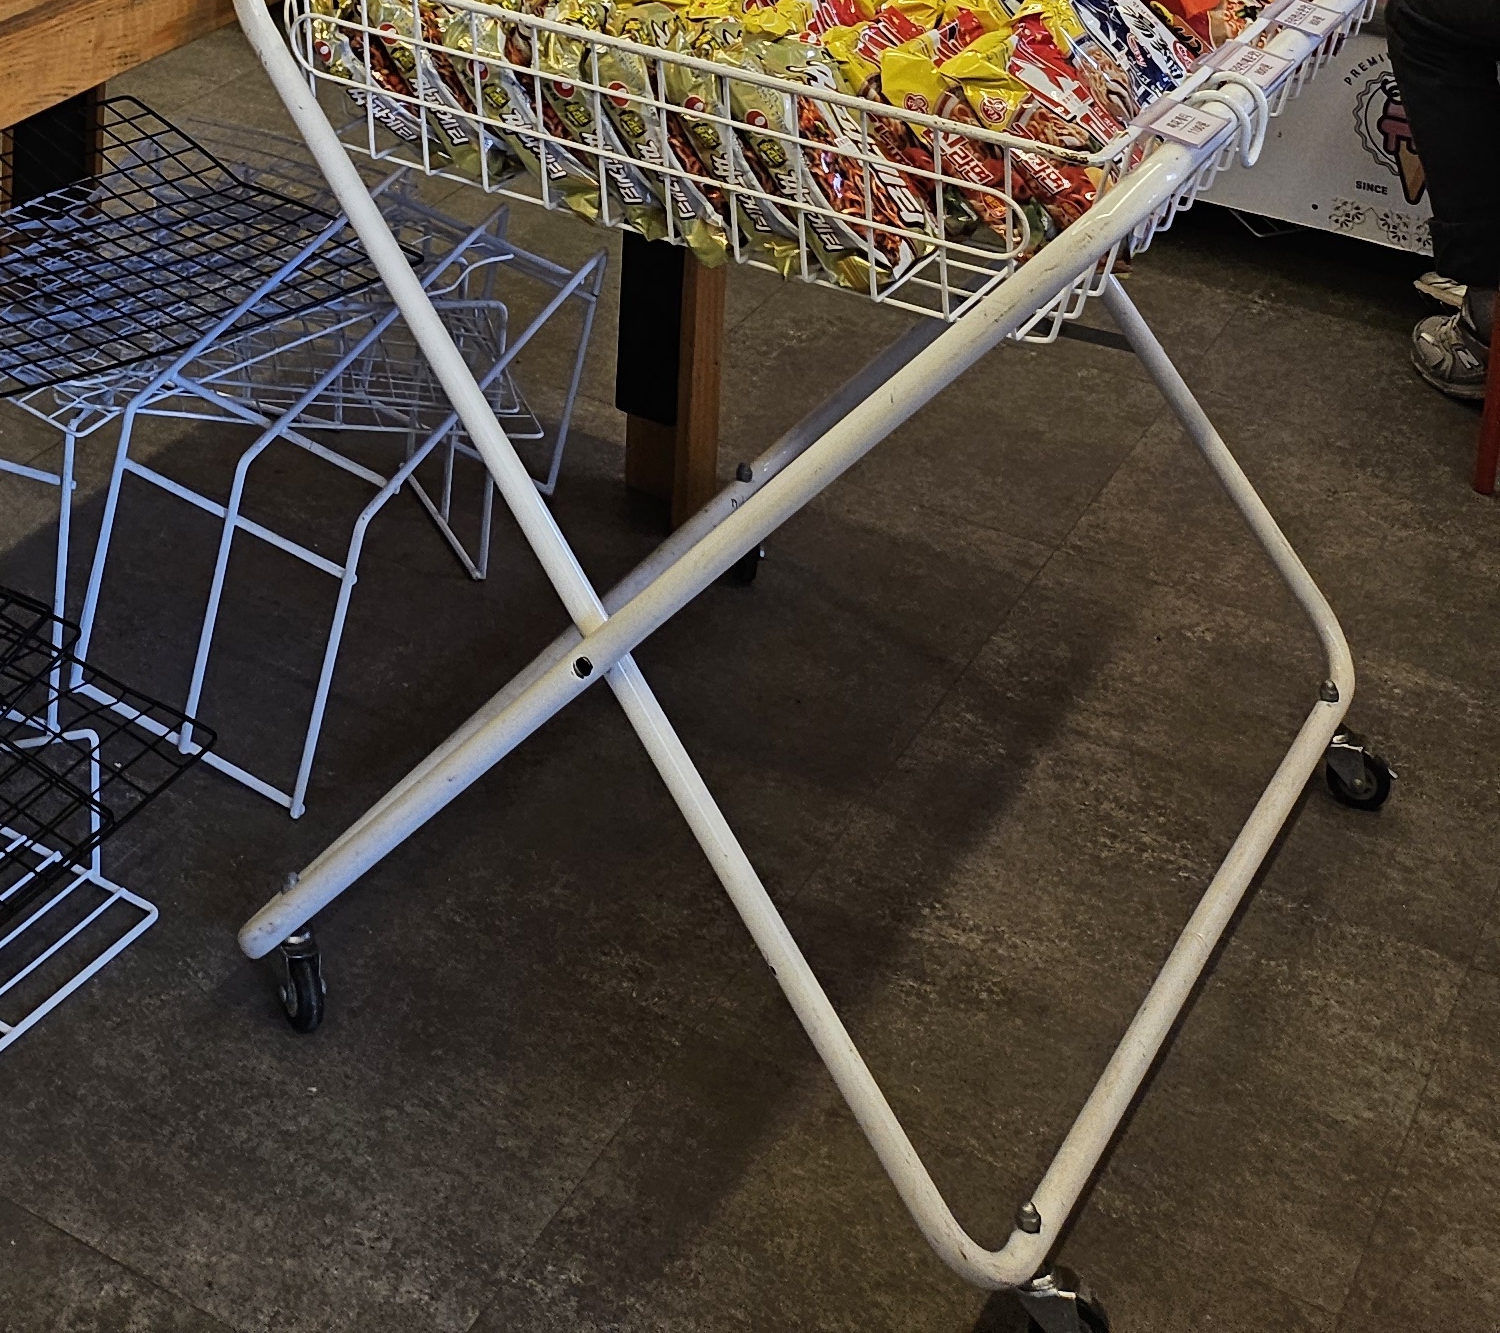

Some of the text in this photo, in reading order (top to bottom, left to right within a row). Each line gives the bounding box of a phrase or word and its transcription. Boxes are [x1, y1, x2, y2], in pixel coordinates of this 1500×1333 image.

[1343, 52, 1391, 86] PREMI
[409, 77, 469, 147] 짜파게티
[1355, 179, 1389, 196] SINCE
